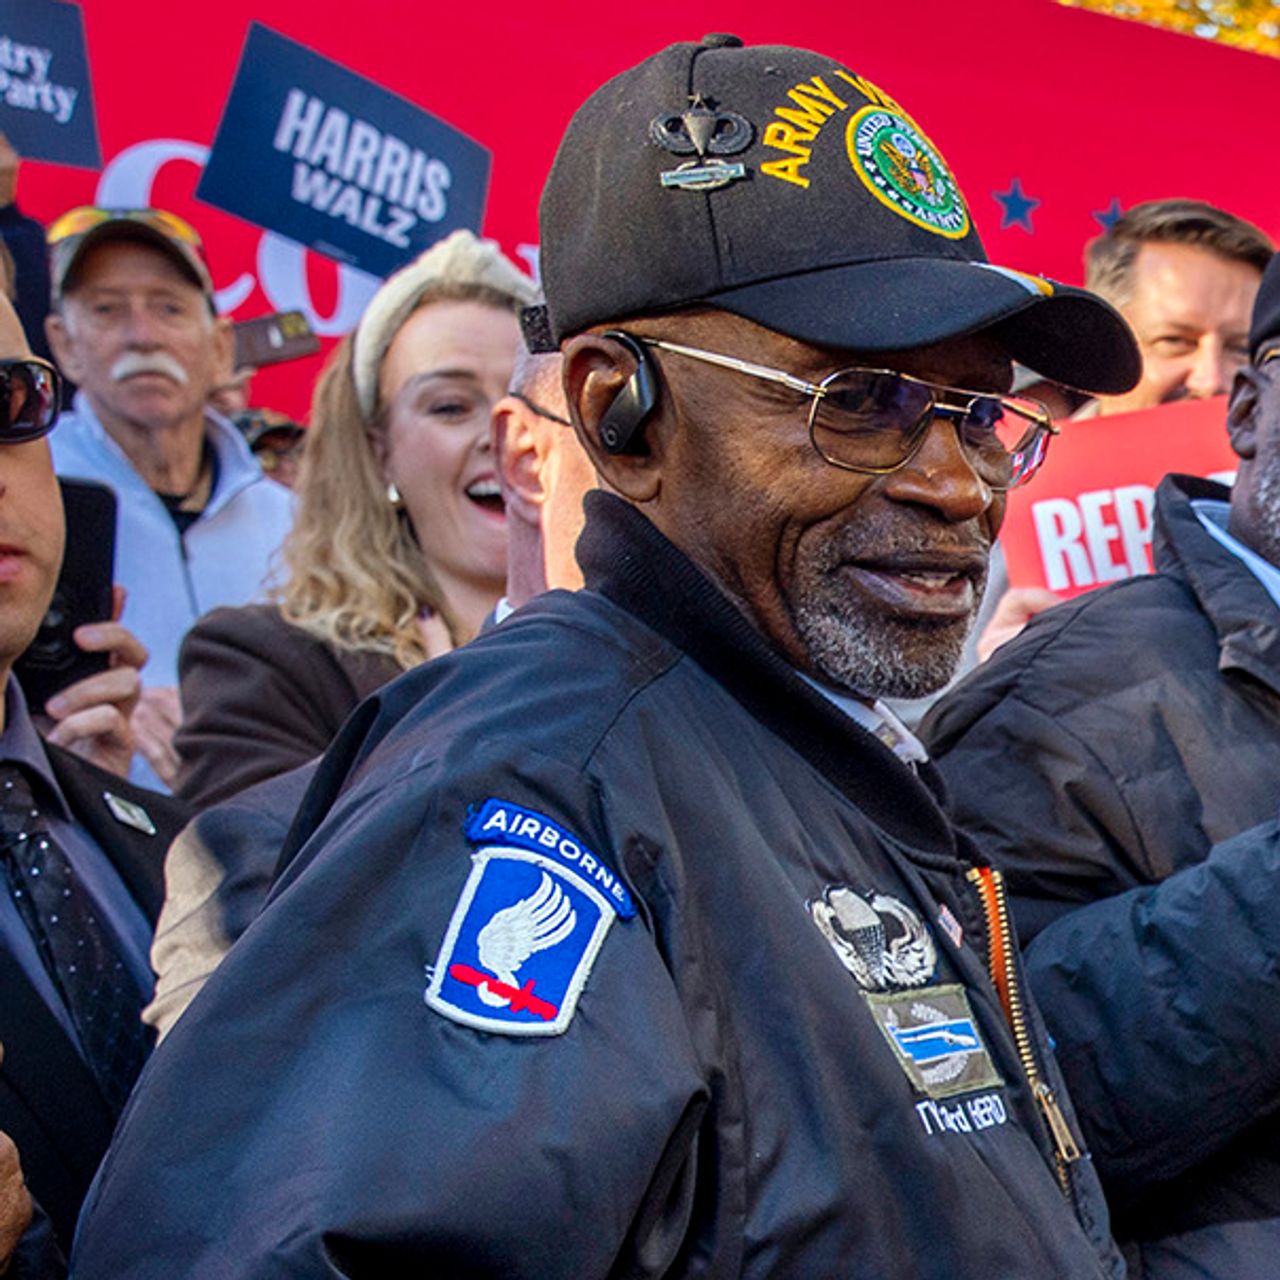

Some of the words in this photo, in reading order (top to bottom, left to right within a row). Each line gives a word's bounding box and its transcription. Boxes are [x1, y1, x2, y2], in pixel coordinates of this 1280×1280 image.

[272, 86, 453, 223] HARRIS
[760, 75, 849, 190] ARMY
[290, 161, 418, 249] WALZ
[482, 808, 626, 903] AIRBORNE
